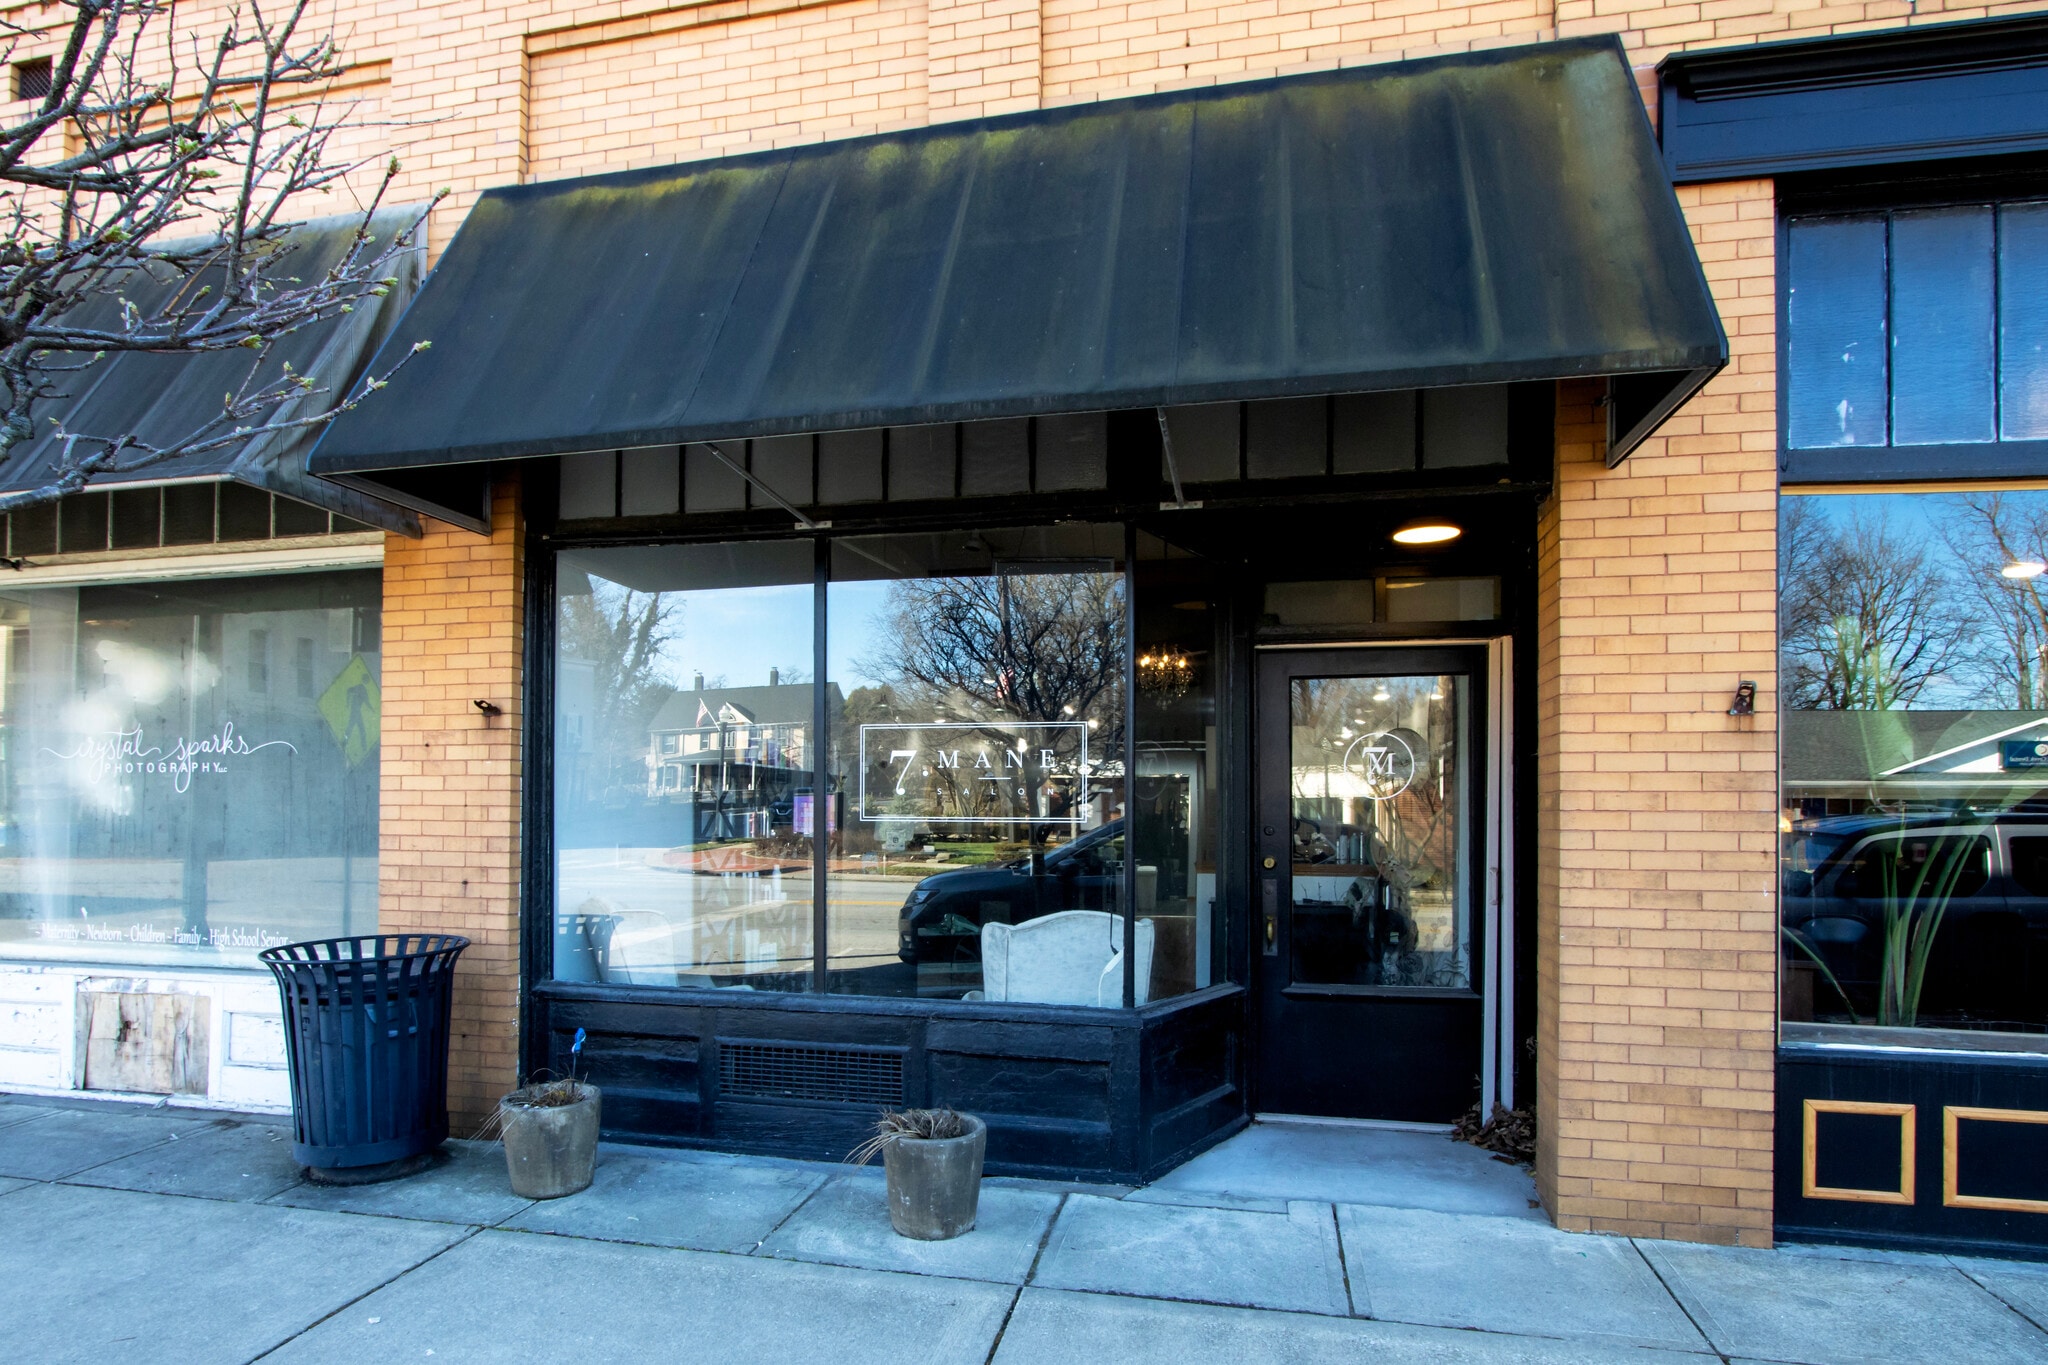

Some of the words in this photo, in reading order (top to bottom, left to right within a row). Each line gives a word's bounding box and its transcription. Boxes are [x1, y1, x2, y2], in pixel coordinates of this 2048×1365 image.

[158, 721, 299, 793] sparks
[936, 749, 1055, 769] MANE
[104, 762, 220, 773] PHOTOGRAPHY
[936, 787, 1055, 796] SALON
[42, 922, 80, 940] Maternity
[87, 922, 122, 941] Newborn
[130, 923, 166, 943] Children
[174, 925, 202, 951] Family
[209, 926, 231, 951] High
[231, 927, 260, 948] School
[260, 929, 289, 948] Senior
